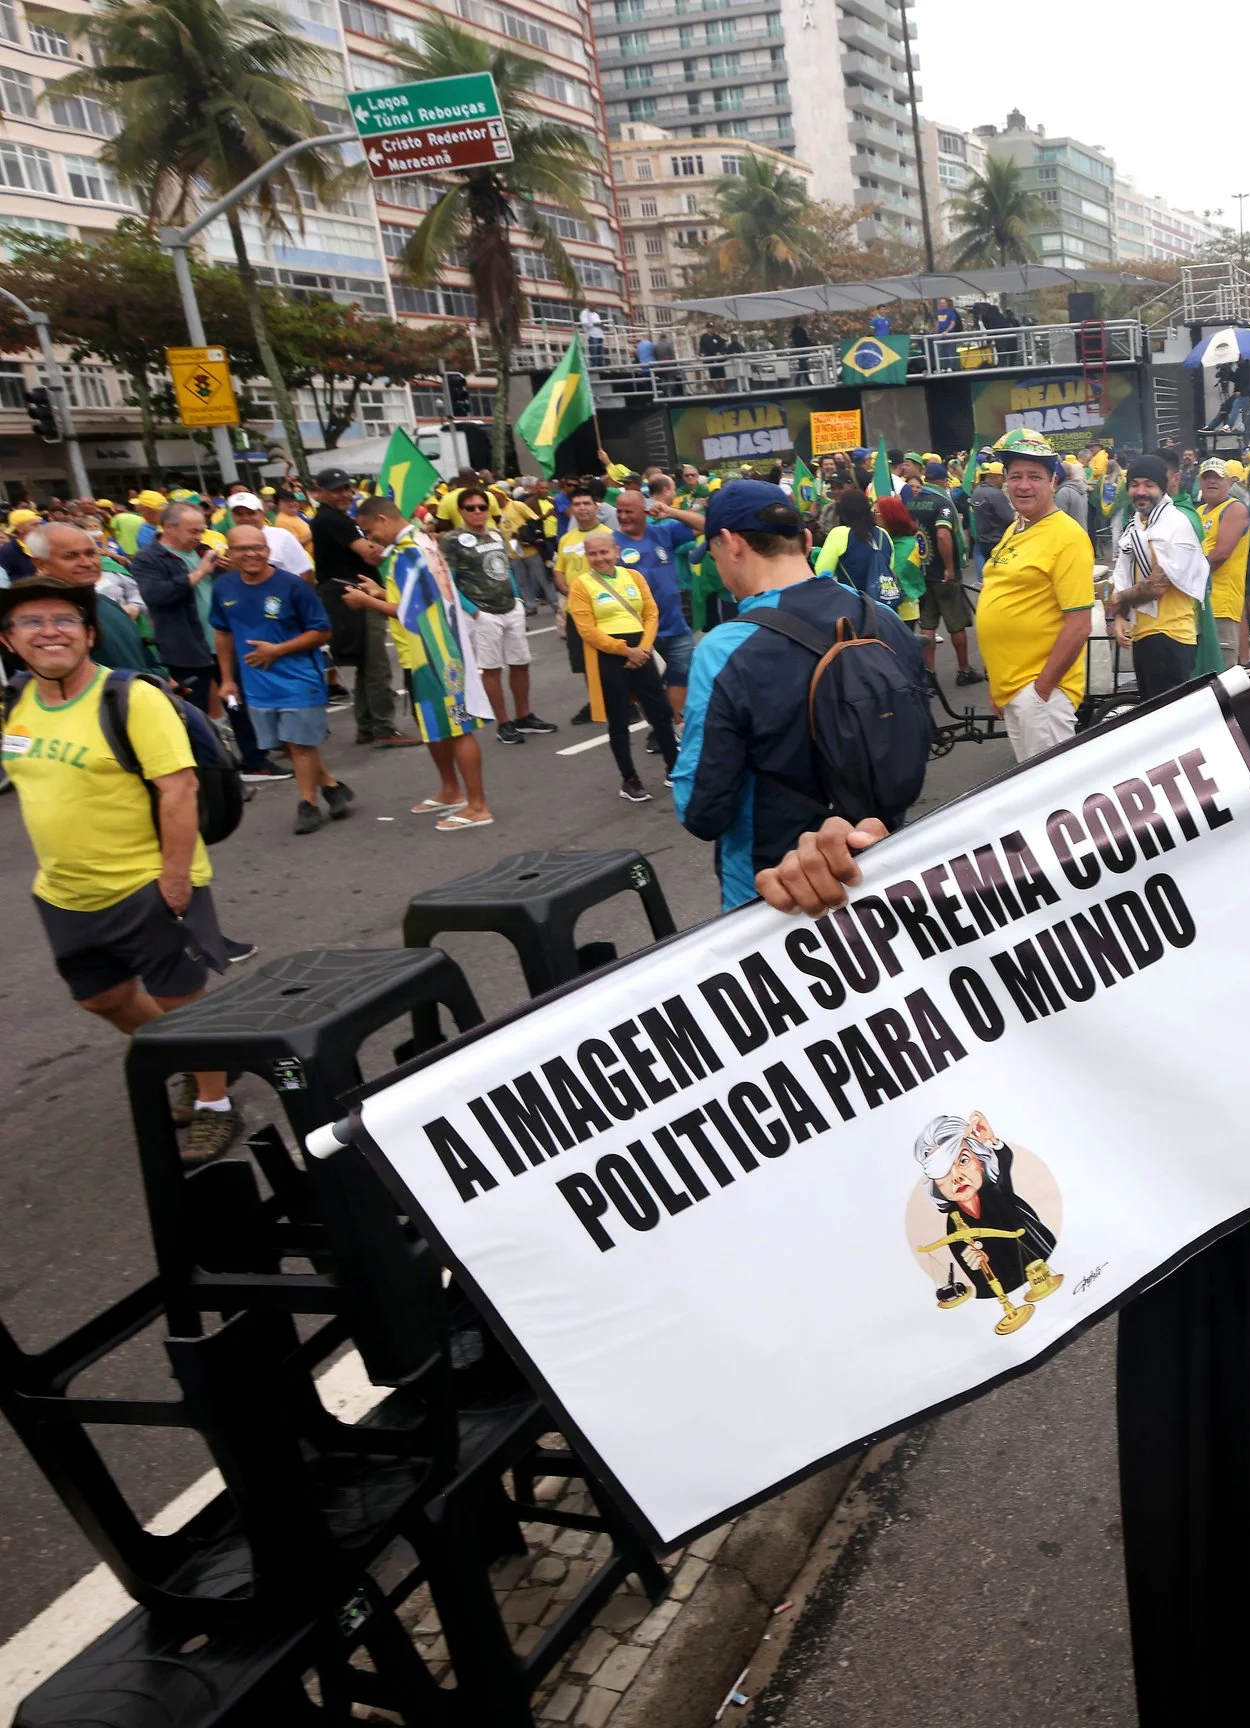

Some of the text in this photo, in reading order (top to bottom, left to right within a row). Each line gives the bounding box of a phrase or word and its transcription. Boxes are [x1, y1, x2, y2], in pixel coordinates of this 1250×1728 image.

[367, 94, 409, 111] Lagoa
[373, 102, 487, 128] Túnel Rebouças
[382, 128, 487, 152] Cristo Redentor
[387, 150, 452, 171] Maracanã
[1011, 381, 1095, 410] REAJA
[705, 404, 784, 436] REAJA
[1005, 404, 1104, 432] BRASIL
[702, 428, 794, 460] BRASIL
[28, 737, 90, 769] ASIL
[422, 747, 1234, 1203] A IMAGEM DA SUPREMA CORTE
[555, 872, 1197, 1253] POLITICA PARA O MUNDO
